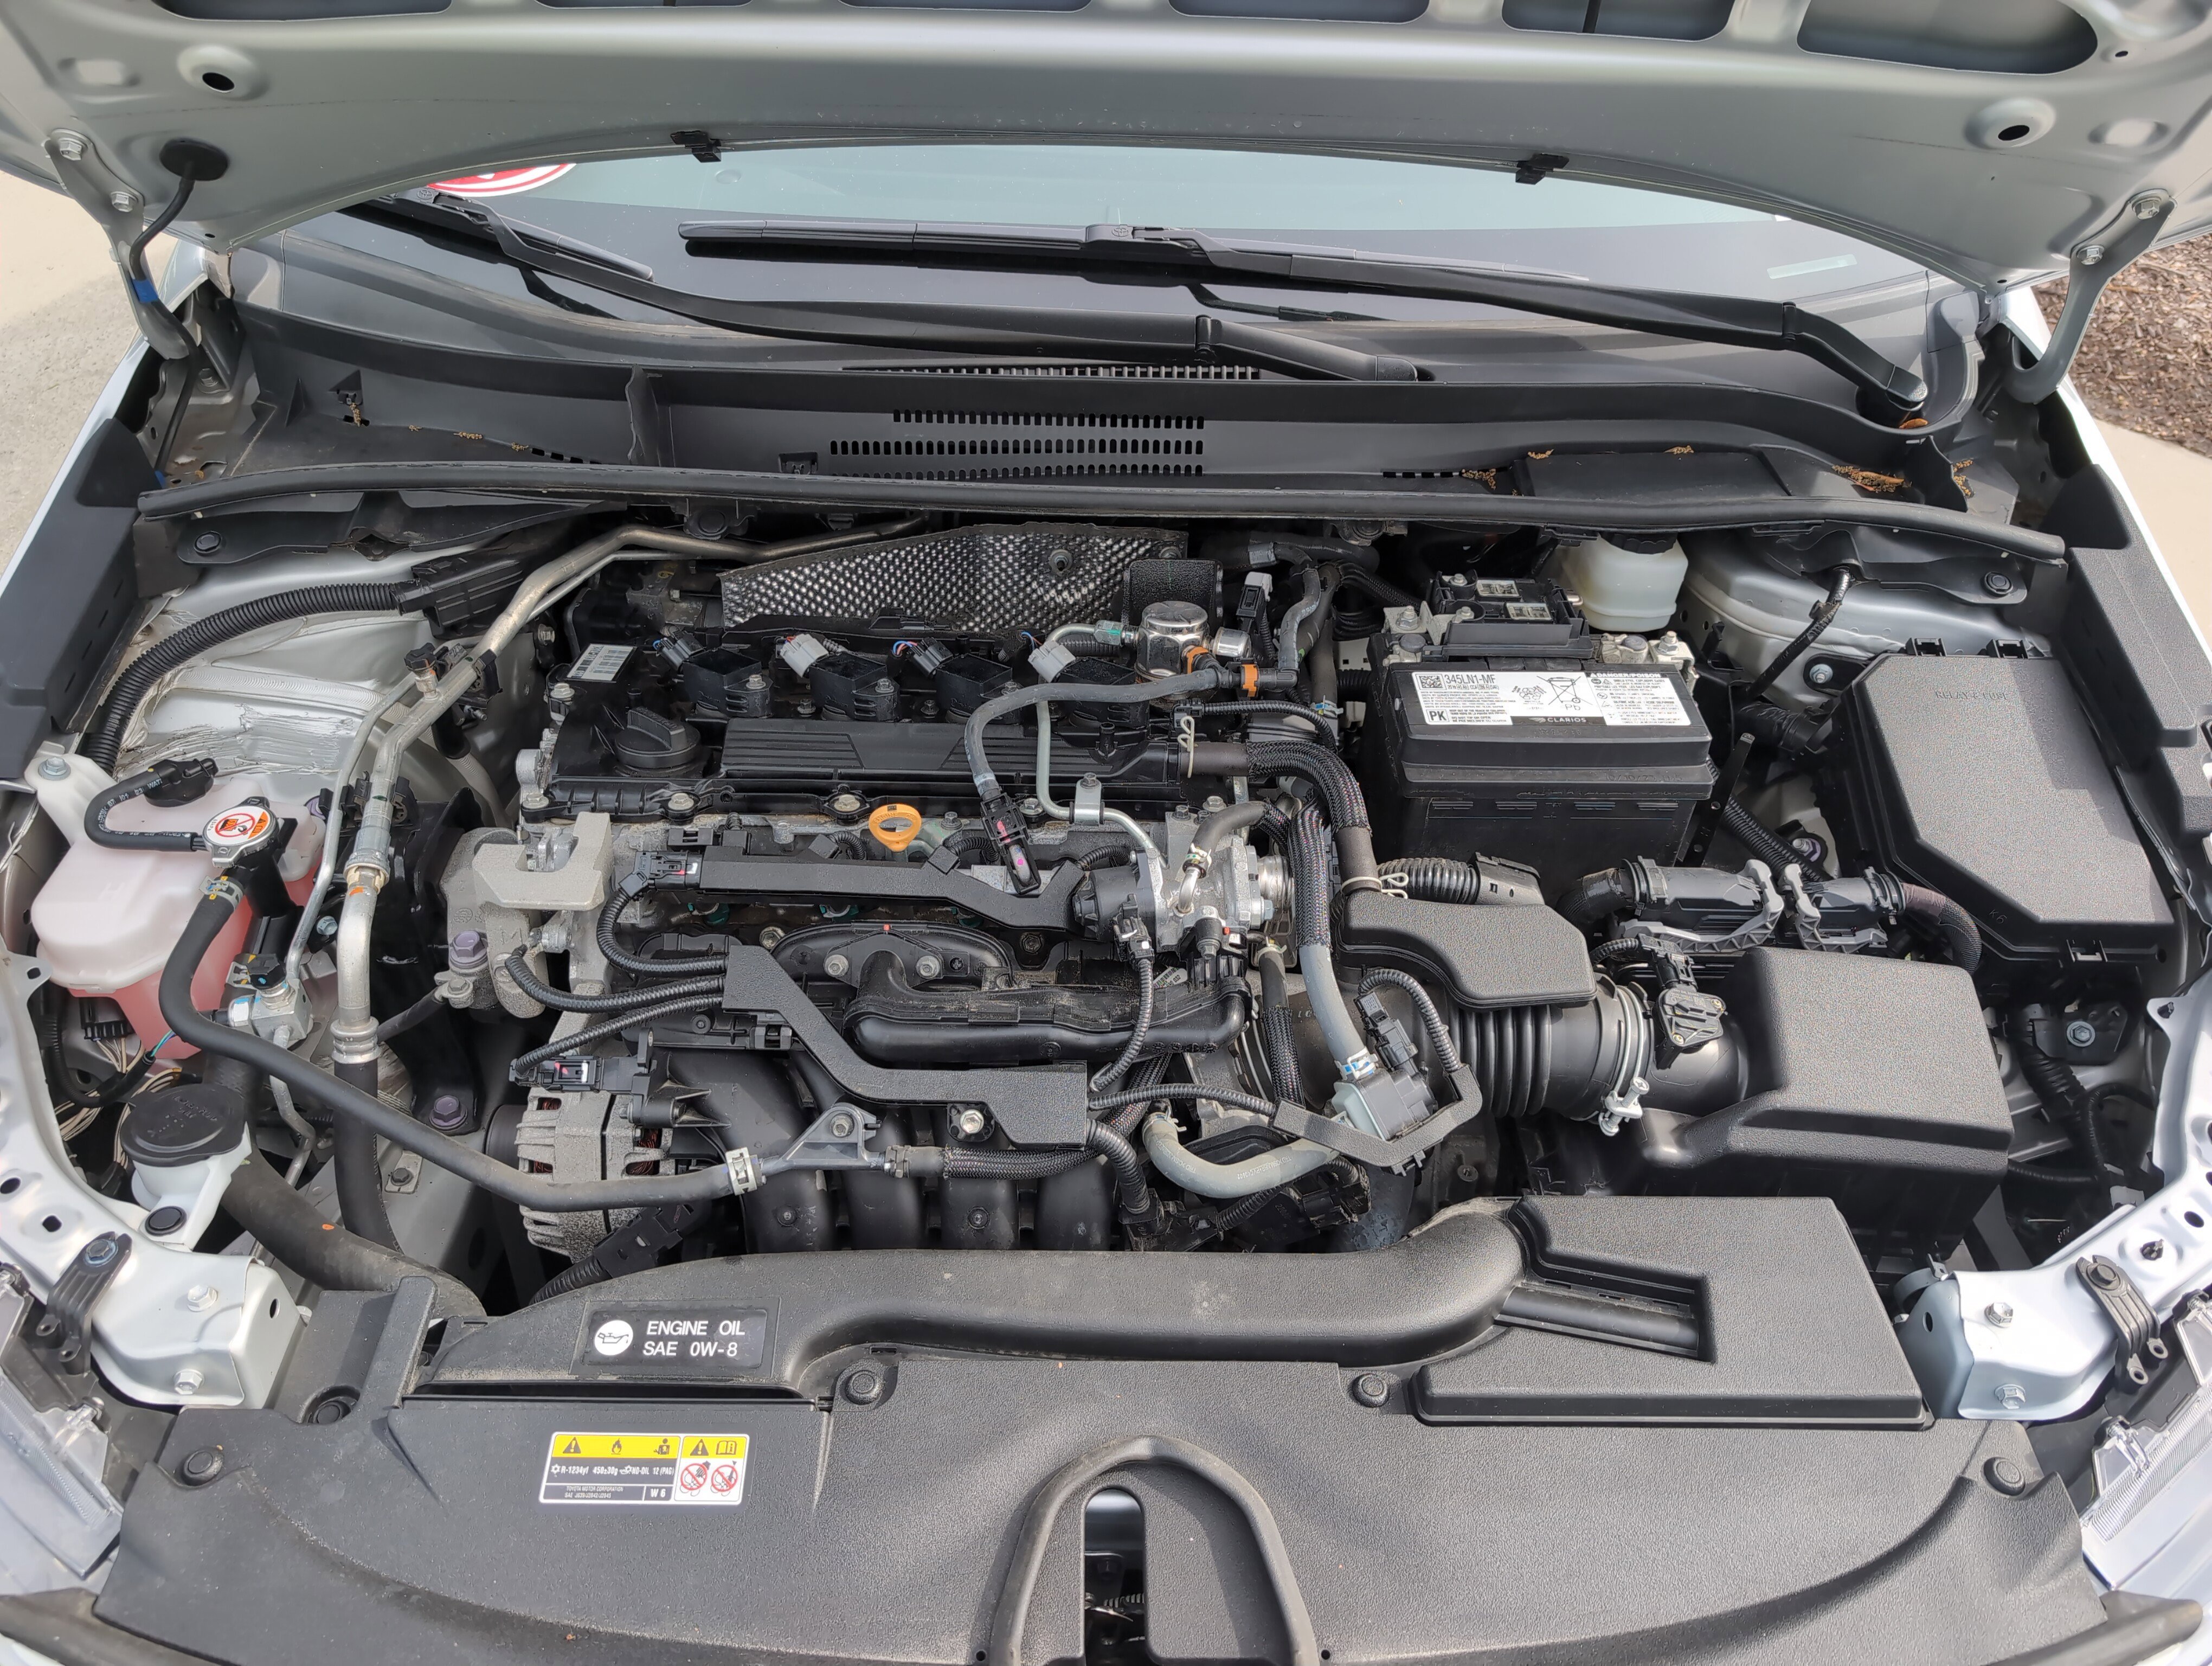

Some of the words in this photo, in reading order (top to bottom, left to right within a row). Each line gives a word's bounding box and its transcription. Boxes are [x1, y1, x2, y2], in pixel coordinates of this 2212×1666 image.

[1444, 674, 1496, 684] 345LN1-MF
[1429, 711, 1446, 721] PK
[647, 1320, 709, 1336] ENGINE
[719, 1320, 745, 1336] OIL
[642, 1341, 678, 1356] SAE
[690, 1341, 738, 1357] 0W-8
[561, 1465, 589, 1476] R-1234yf
[593, 1465, 618, 1476] 450±30g
[660, 1466, 674, 1476] (PAG)
[651, 1488, 658, 1497] W
[660, 1489, 666, 1498] 6
